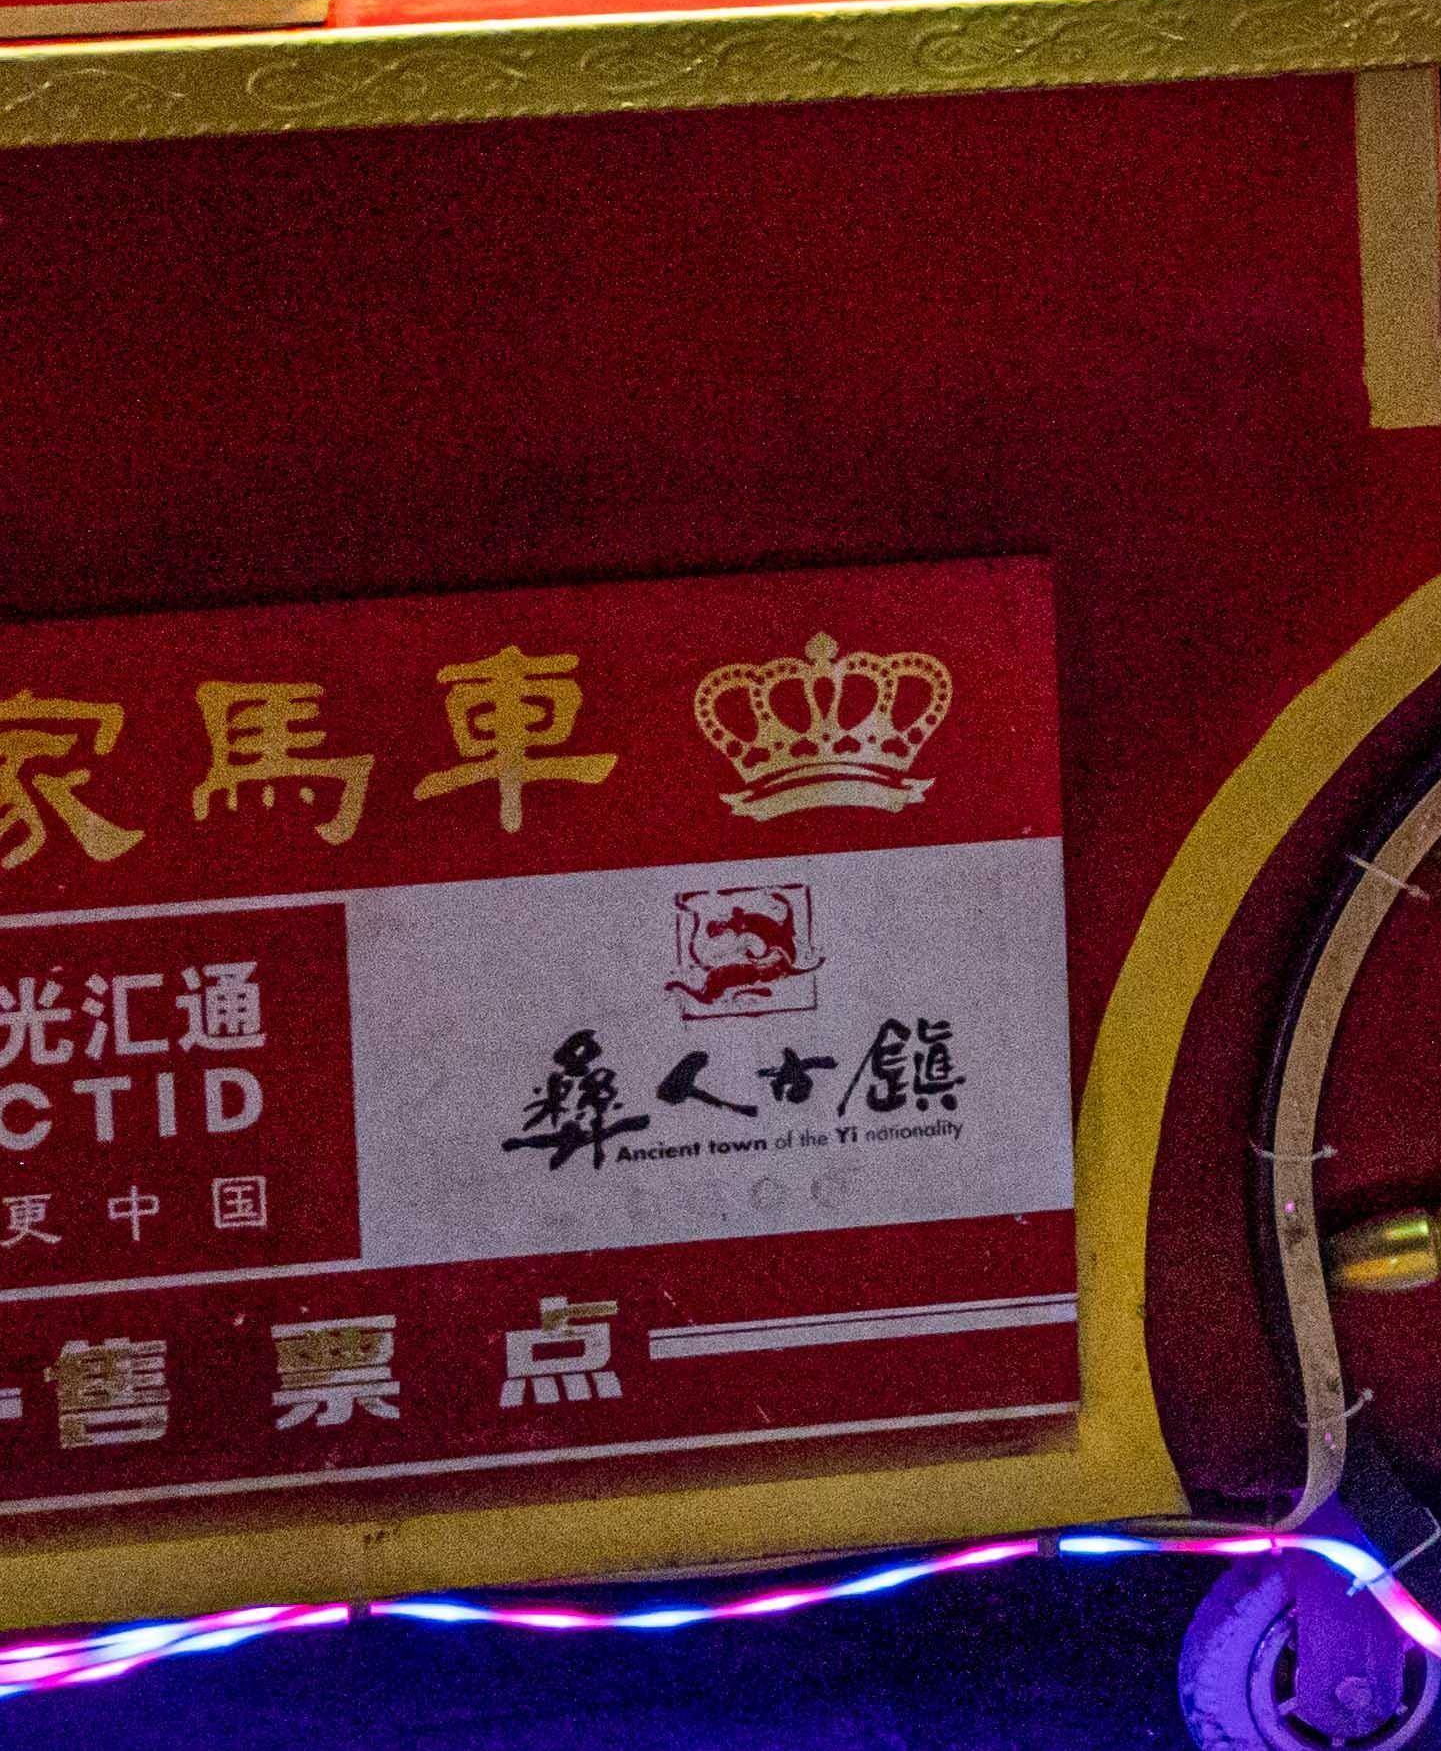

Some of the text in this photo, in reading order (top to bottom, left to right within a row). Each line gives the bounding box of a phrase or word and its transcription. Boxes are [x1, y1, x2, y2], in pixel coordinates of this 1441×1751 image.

[0, 961, 267, 1069] 光汇通
[0, 1068, 264, 1152] CTID
[615, 1119, 964, 1164] Ancient town of the Yi nationality
[42, 1295, 626, 1450] 售票点
